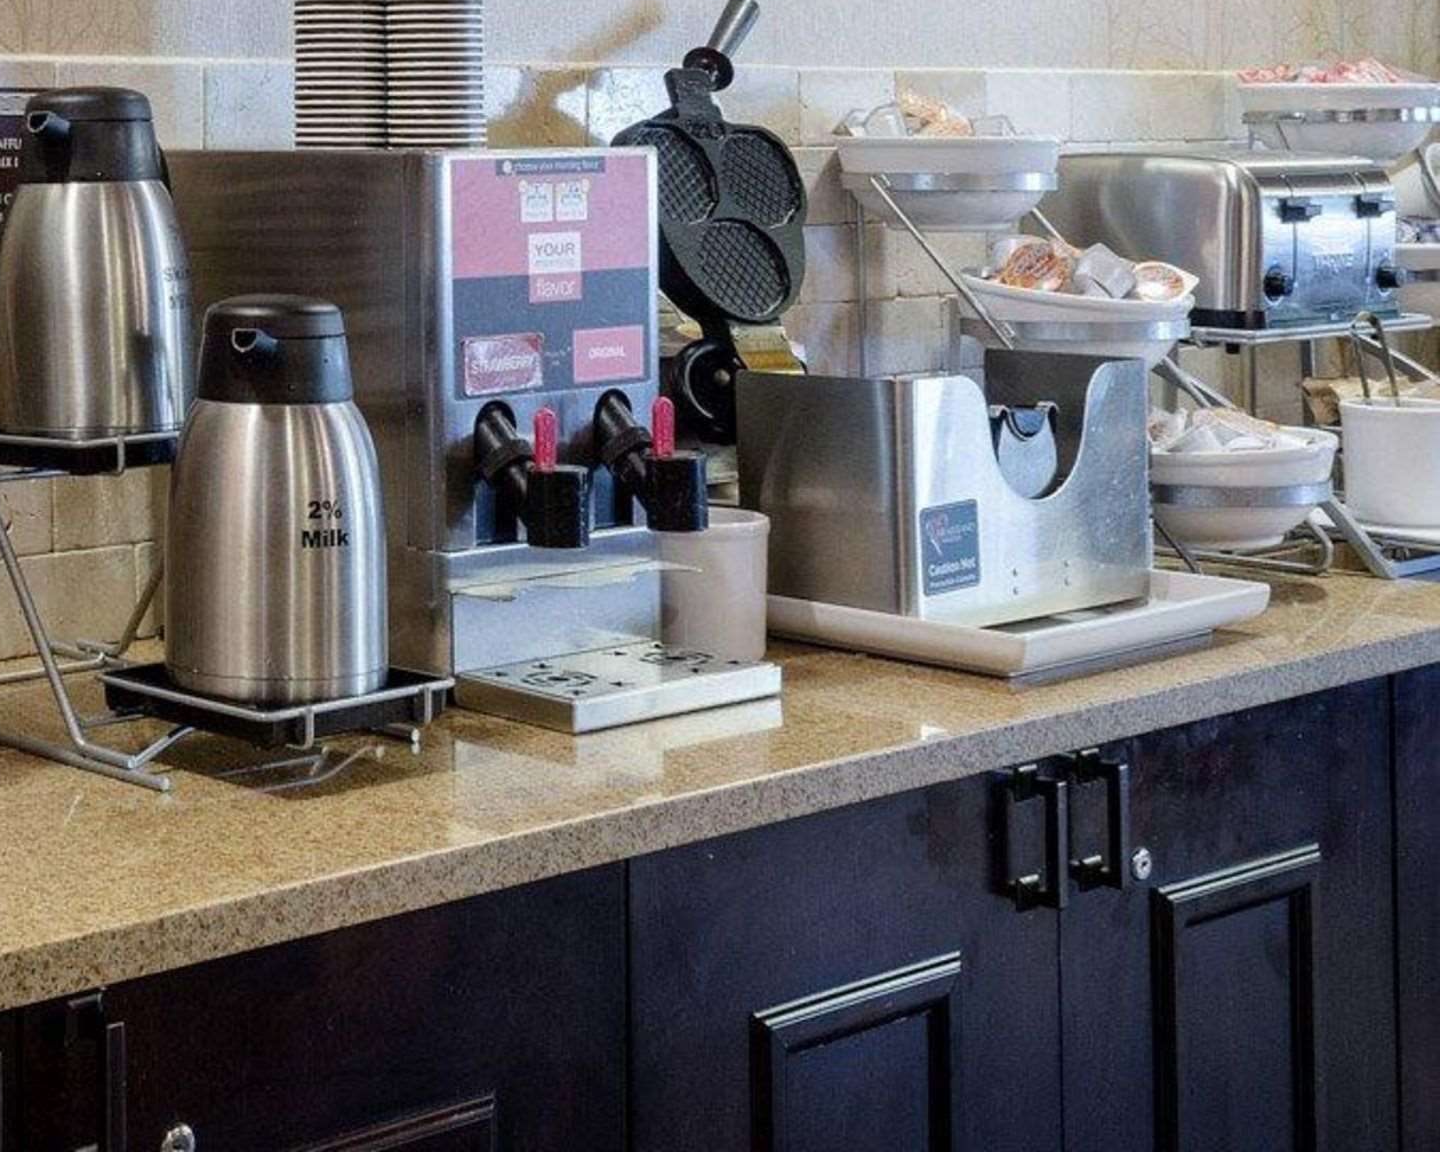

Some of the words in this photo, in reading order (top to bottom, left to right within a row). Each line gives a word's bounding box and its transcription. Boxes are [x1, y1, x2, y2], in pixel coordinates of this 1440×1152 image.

[535, 242, 575, 257] YOUR
[308, 500, 343, 521] 2%
[301, 529, 350, 549] Milk
